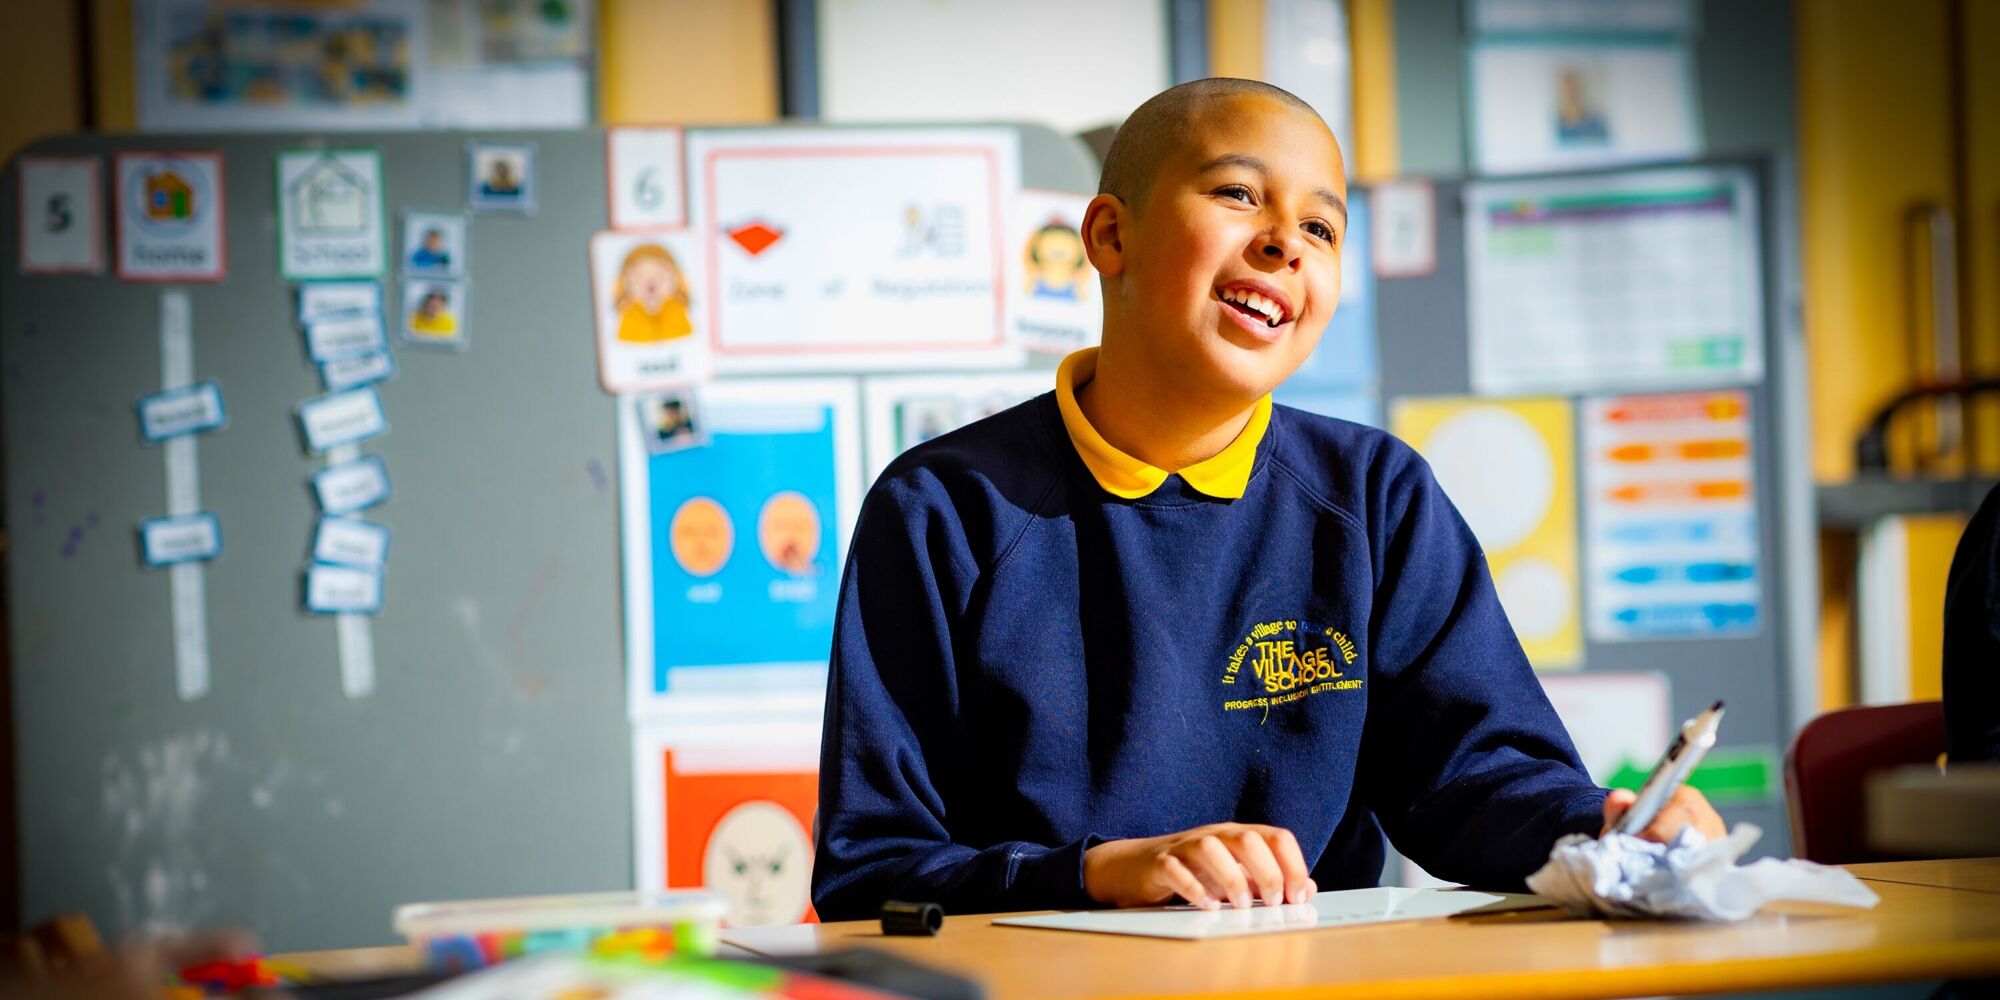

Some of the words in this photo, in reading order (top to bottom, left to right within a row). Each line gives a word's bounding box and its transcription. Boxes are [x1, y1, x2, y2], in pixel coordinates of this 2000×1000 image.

[633, 166, 663, 210] 6
[46, 194, 71, 233] 5
[1251, 620, 1284, 639] village
[1285, 620, 1297, 630] to
[1325, 626, 1334, 636] a
[1245, 636, 1254, 646] a
[1255, 641, 1294, 659] THE
[1226, 644, 1249, 673] takes
[1251, 647, 1330, 679] VILLAGE
[1222, 674, 1235, 684] It
[1264, 660, 1343, 693] SCHOOL
[1224, 697, 1268, 711] PROGRESS
[1271, 688, 1309, 705] INCLUSION
[1311, 679, 1363, 694] ENTITLEMENT
